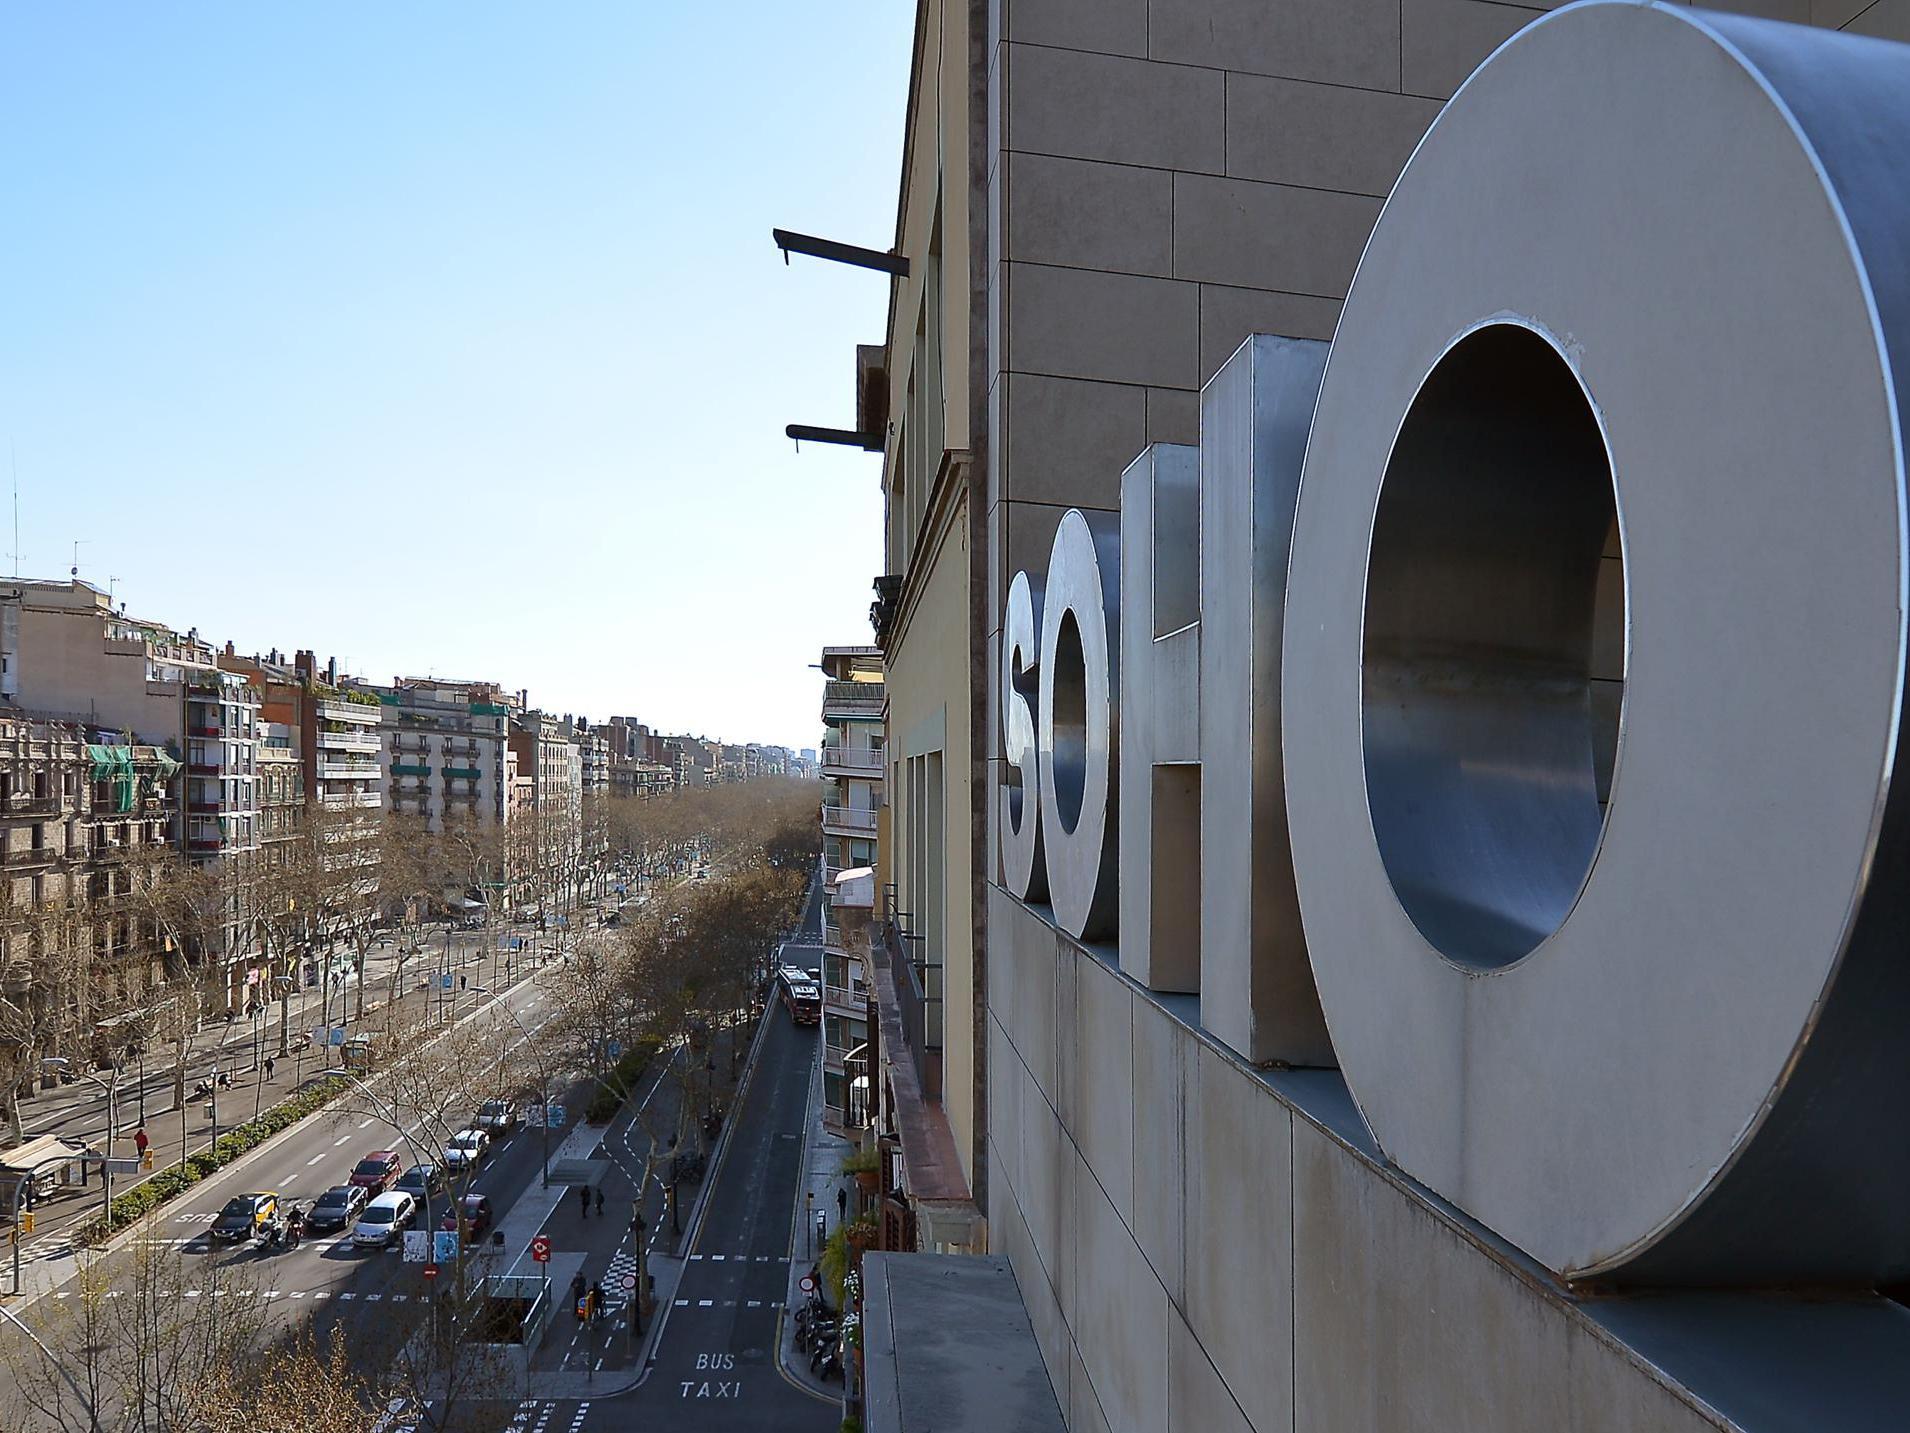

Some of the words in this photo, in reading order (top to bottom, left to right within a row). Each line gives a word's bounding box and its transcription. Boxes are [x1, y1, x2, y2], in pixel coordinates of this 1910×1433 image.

[1000, 0, 1909, 1280] SOHO
[696, 1353, 735, 1370] BUS
[680, 1382, 741, 1398] TAXI
